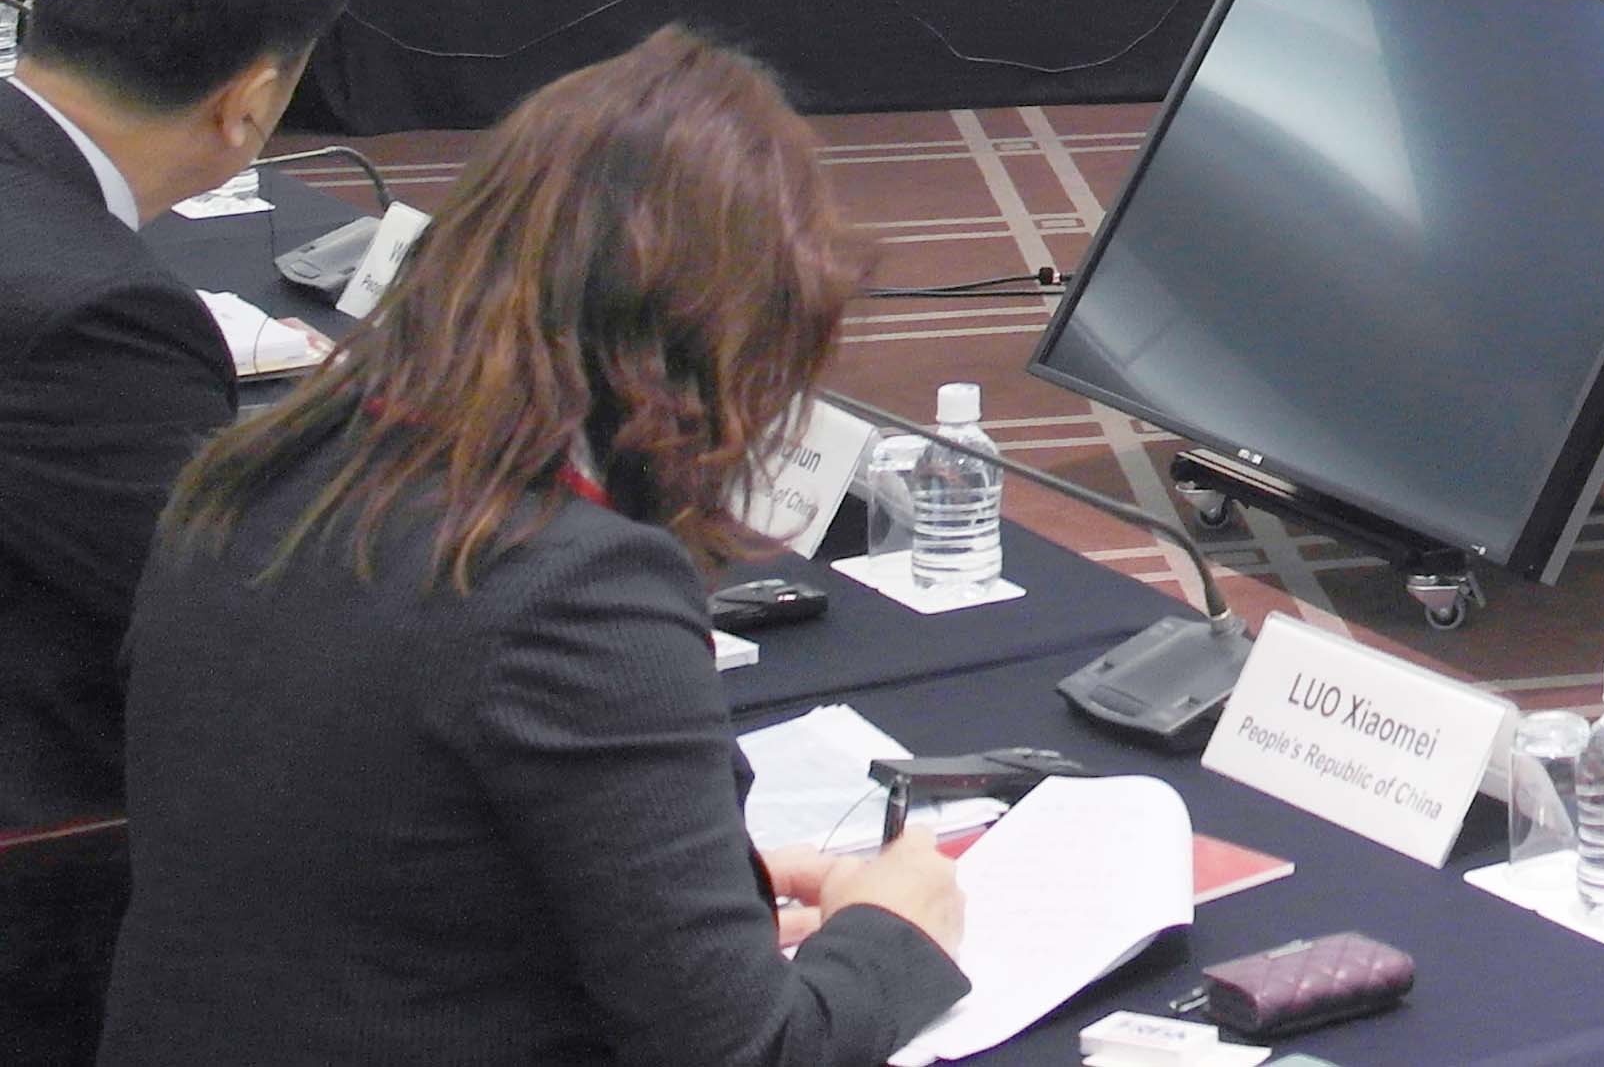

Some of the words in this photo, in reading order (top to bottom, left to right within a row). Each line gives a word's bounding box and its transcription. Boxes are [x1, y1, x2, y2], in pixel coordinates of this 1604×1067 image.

[1287, 672, 1341, 717] LUO
[1341, 694, 1441, 761] Xiaomei
[1304, 743, 1374, 791] Republic
[1375, 775, 1395, 799] of
[1395, 781, 1443, 821] China
